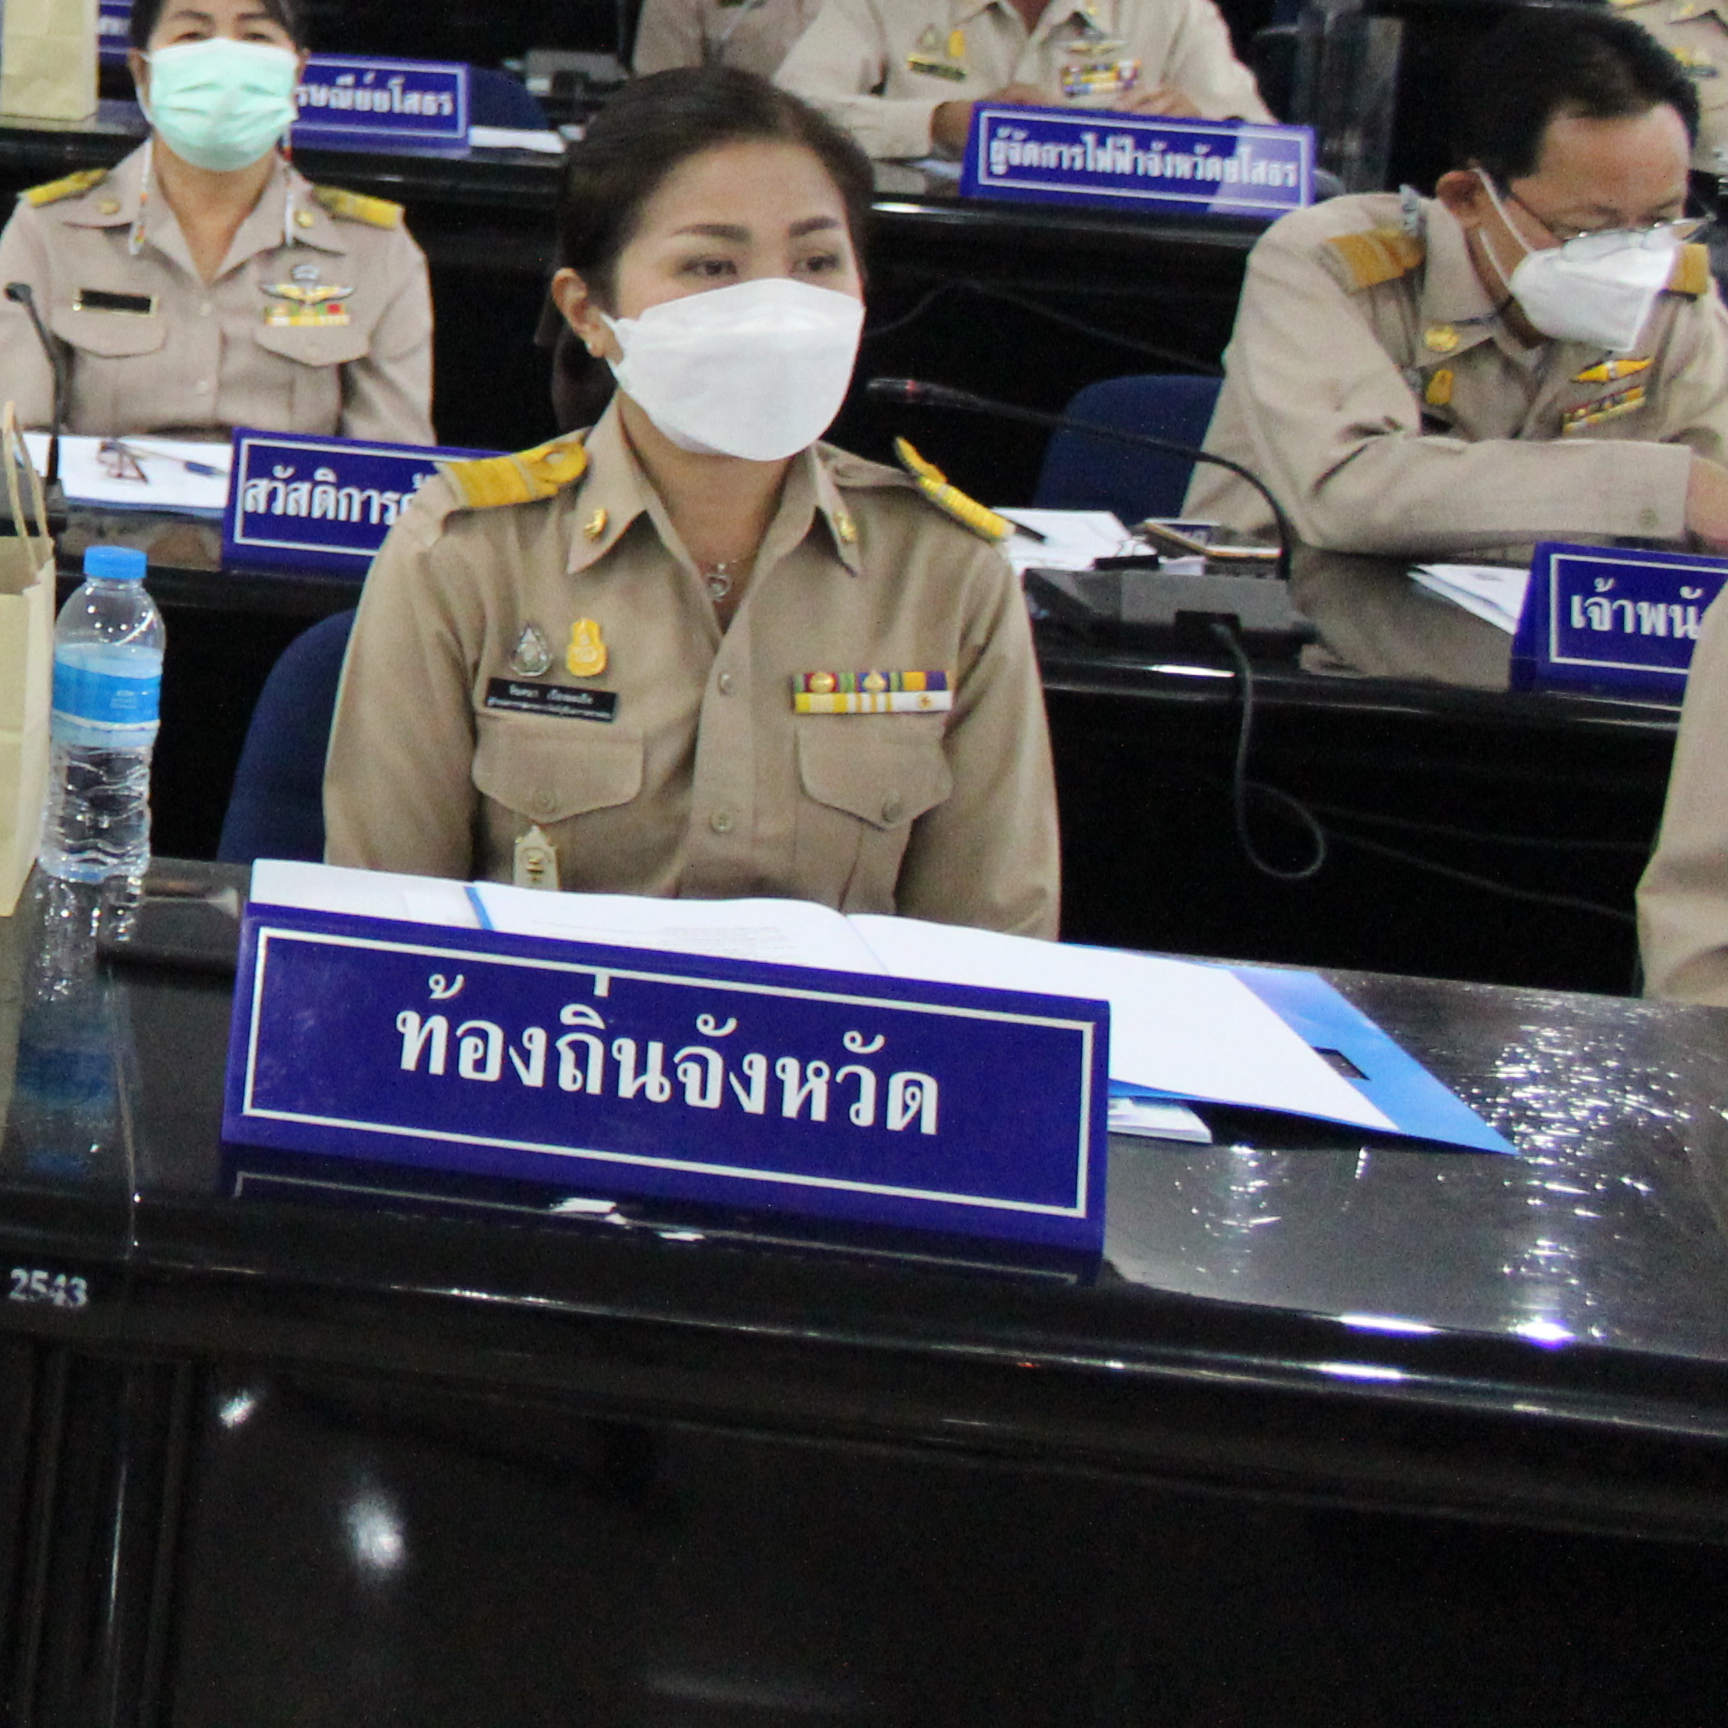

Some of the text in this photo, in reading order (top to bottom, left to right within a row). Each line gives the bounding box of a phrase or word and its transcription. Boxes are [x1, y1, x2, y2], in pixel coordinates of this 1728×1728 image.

[1570, 576, 1705, 640] เจ้าพนั
[395, 969, 939, 1136] ท้องถิ่นจังหวัด
